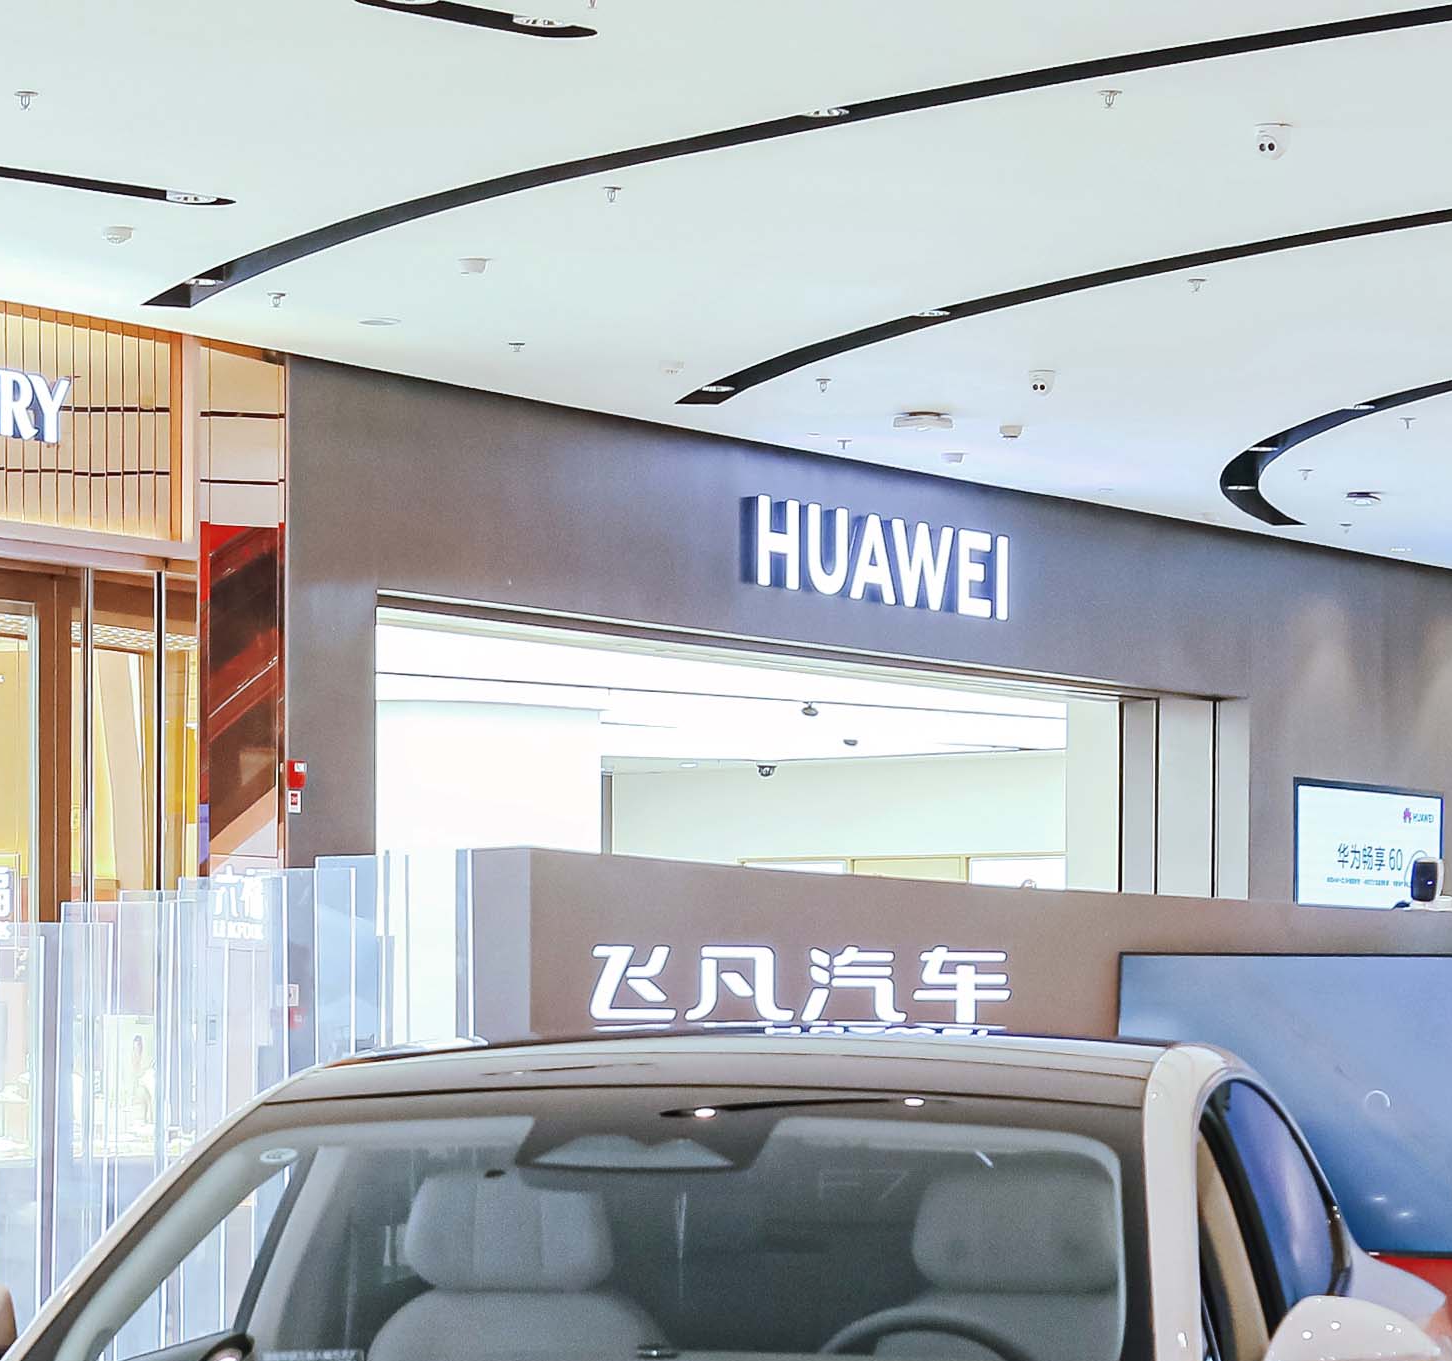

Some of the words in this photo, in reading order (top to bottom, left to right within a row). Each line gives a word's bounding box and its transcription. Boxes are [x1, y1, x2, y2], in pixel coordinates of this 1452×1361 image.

[749, 491, 1011, 622] HUAWEI
[1412, 812, 1435, 824] HUAWEI
[1336, 842, 1386, 871] 华为畅享
[1388, 848, 1404, 871] 60
[589, 944, 1012, 1024] 飞凡汽车
